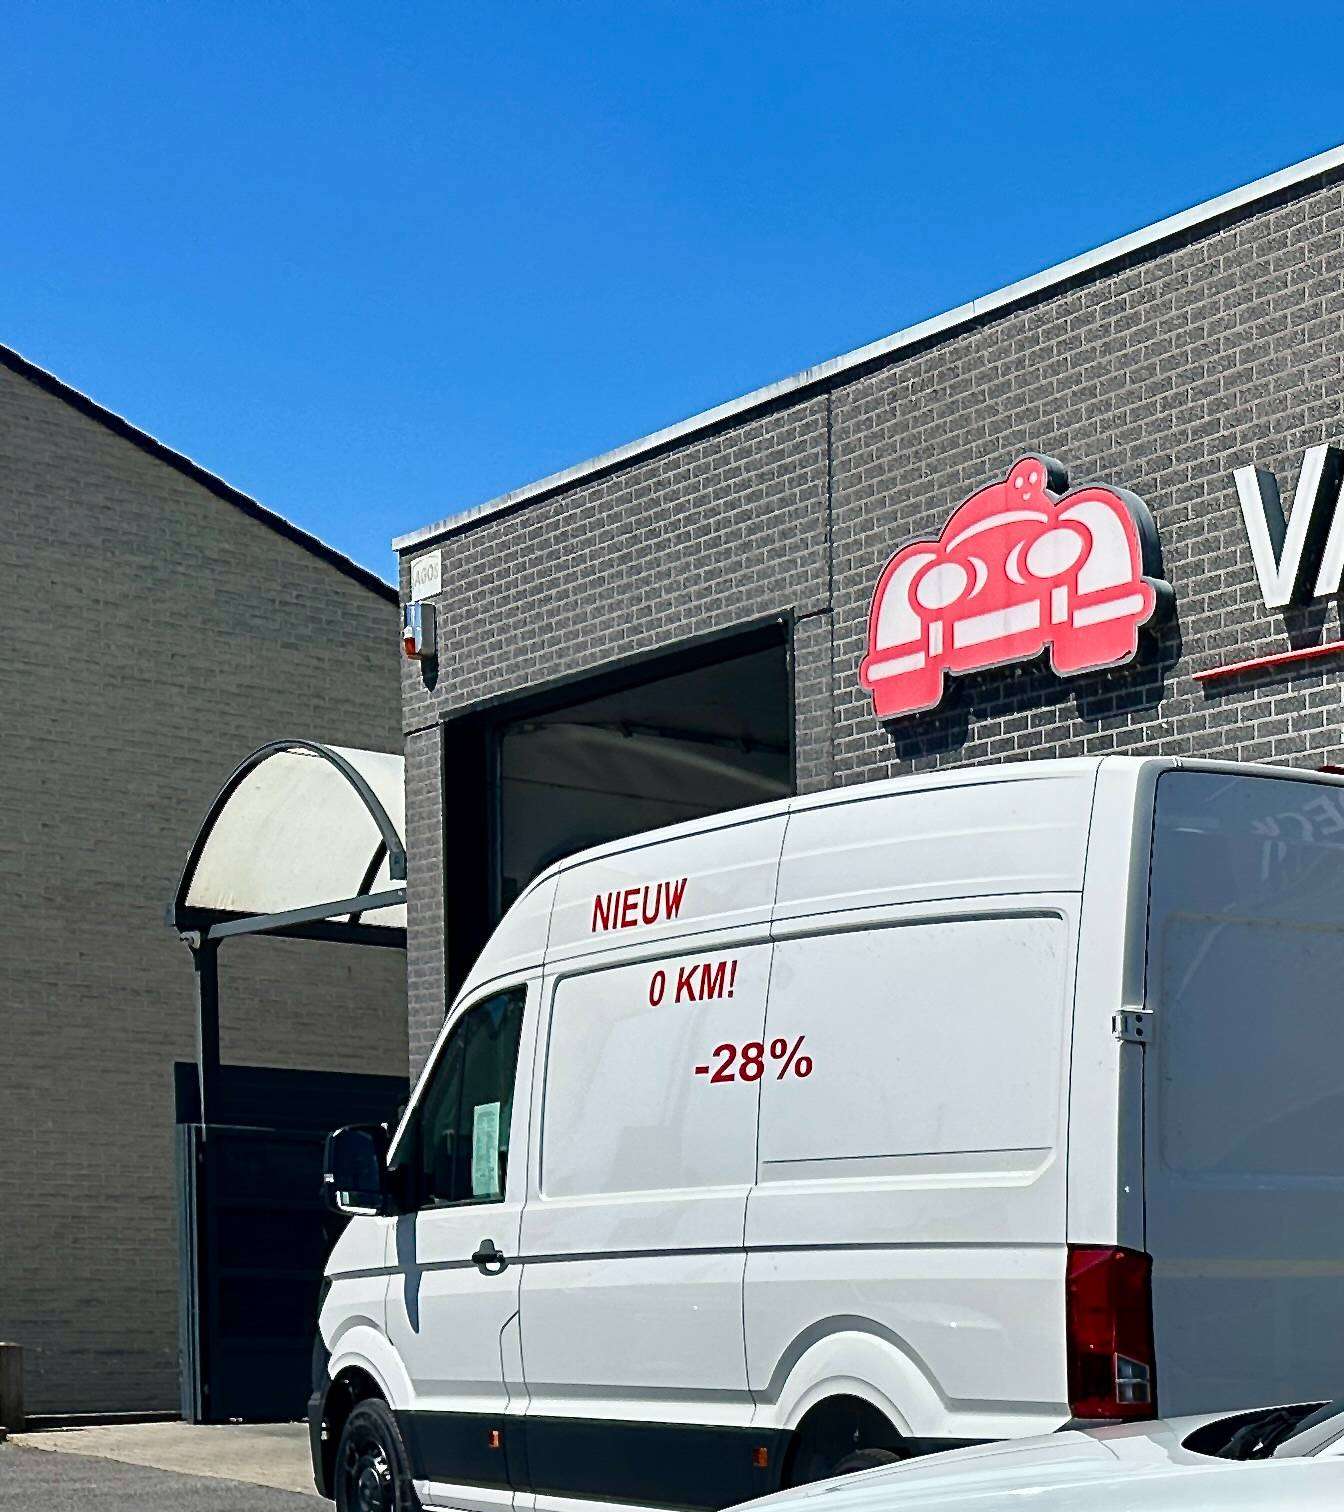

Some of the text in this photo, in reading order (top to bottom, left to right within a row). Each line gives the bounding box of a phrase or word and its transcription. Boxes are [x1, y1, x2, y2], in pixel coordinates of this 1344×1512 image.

[592, 877, 688, 932] NIEUW
[649, 960, 738, 1007] 0 KM!
[695, 1035, 813, 1084] -28%
